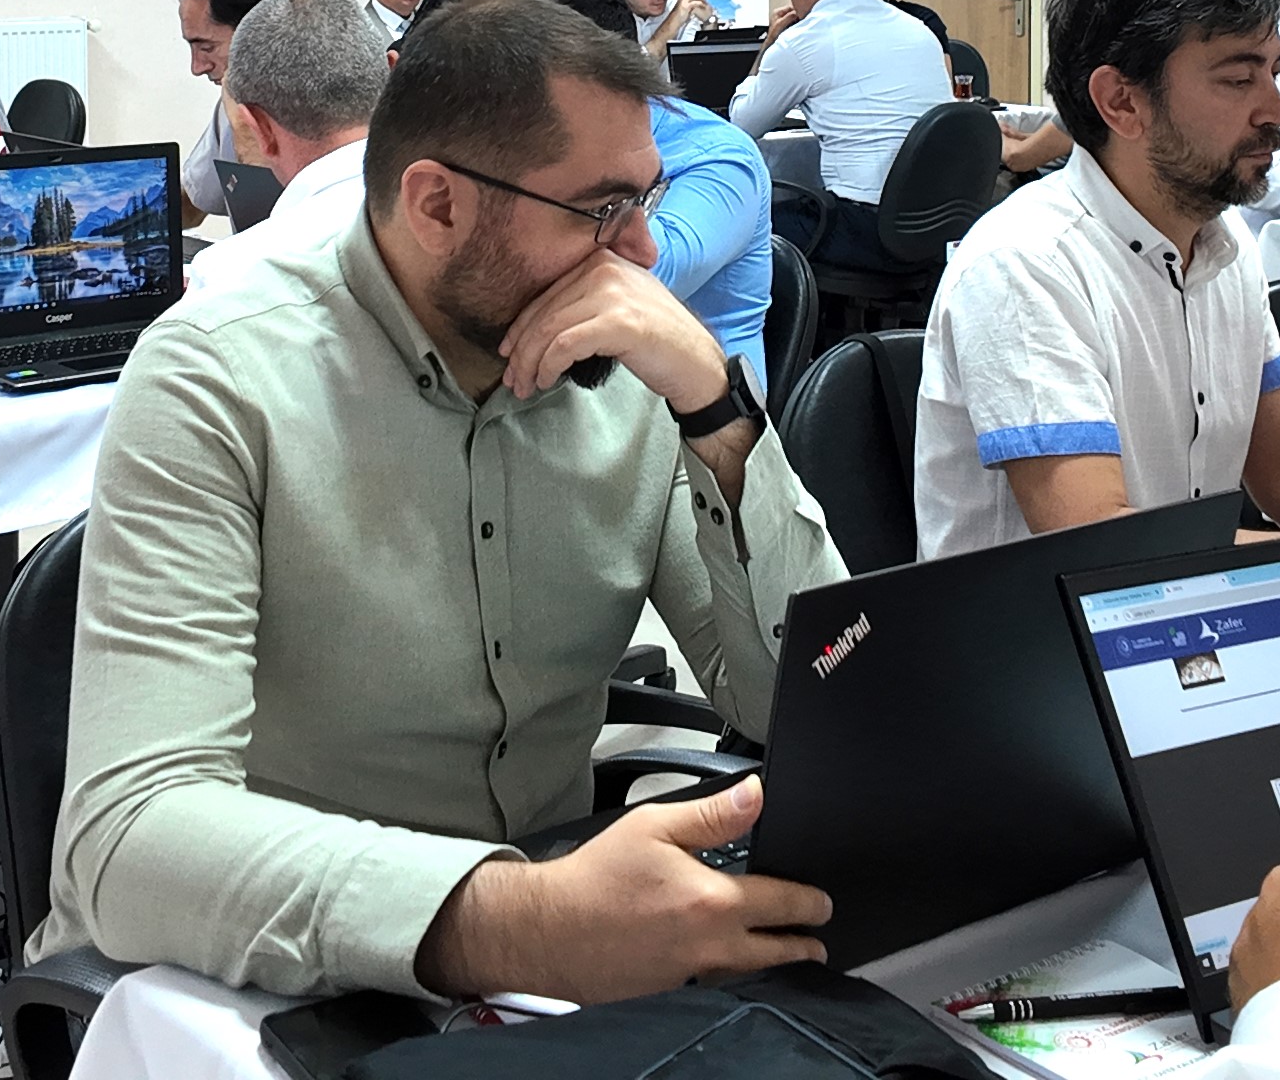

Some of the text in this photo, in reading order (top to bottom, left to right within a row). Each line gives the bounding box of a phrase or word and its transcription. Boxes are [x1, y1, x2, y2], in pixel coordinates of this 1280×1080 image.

[45, 313, 74, 324] Casper
[1214, 617, 1243, 631] Zafer
[811, 611, 872, 680] ThinkPad
